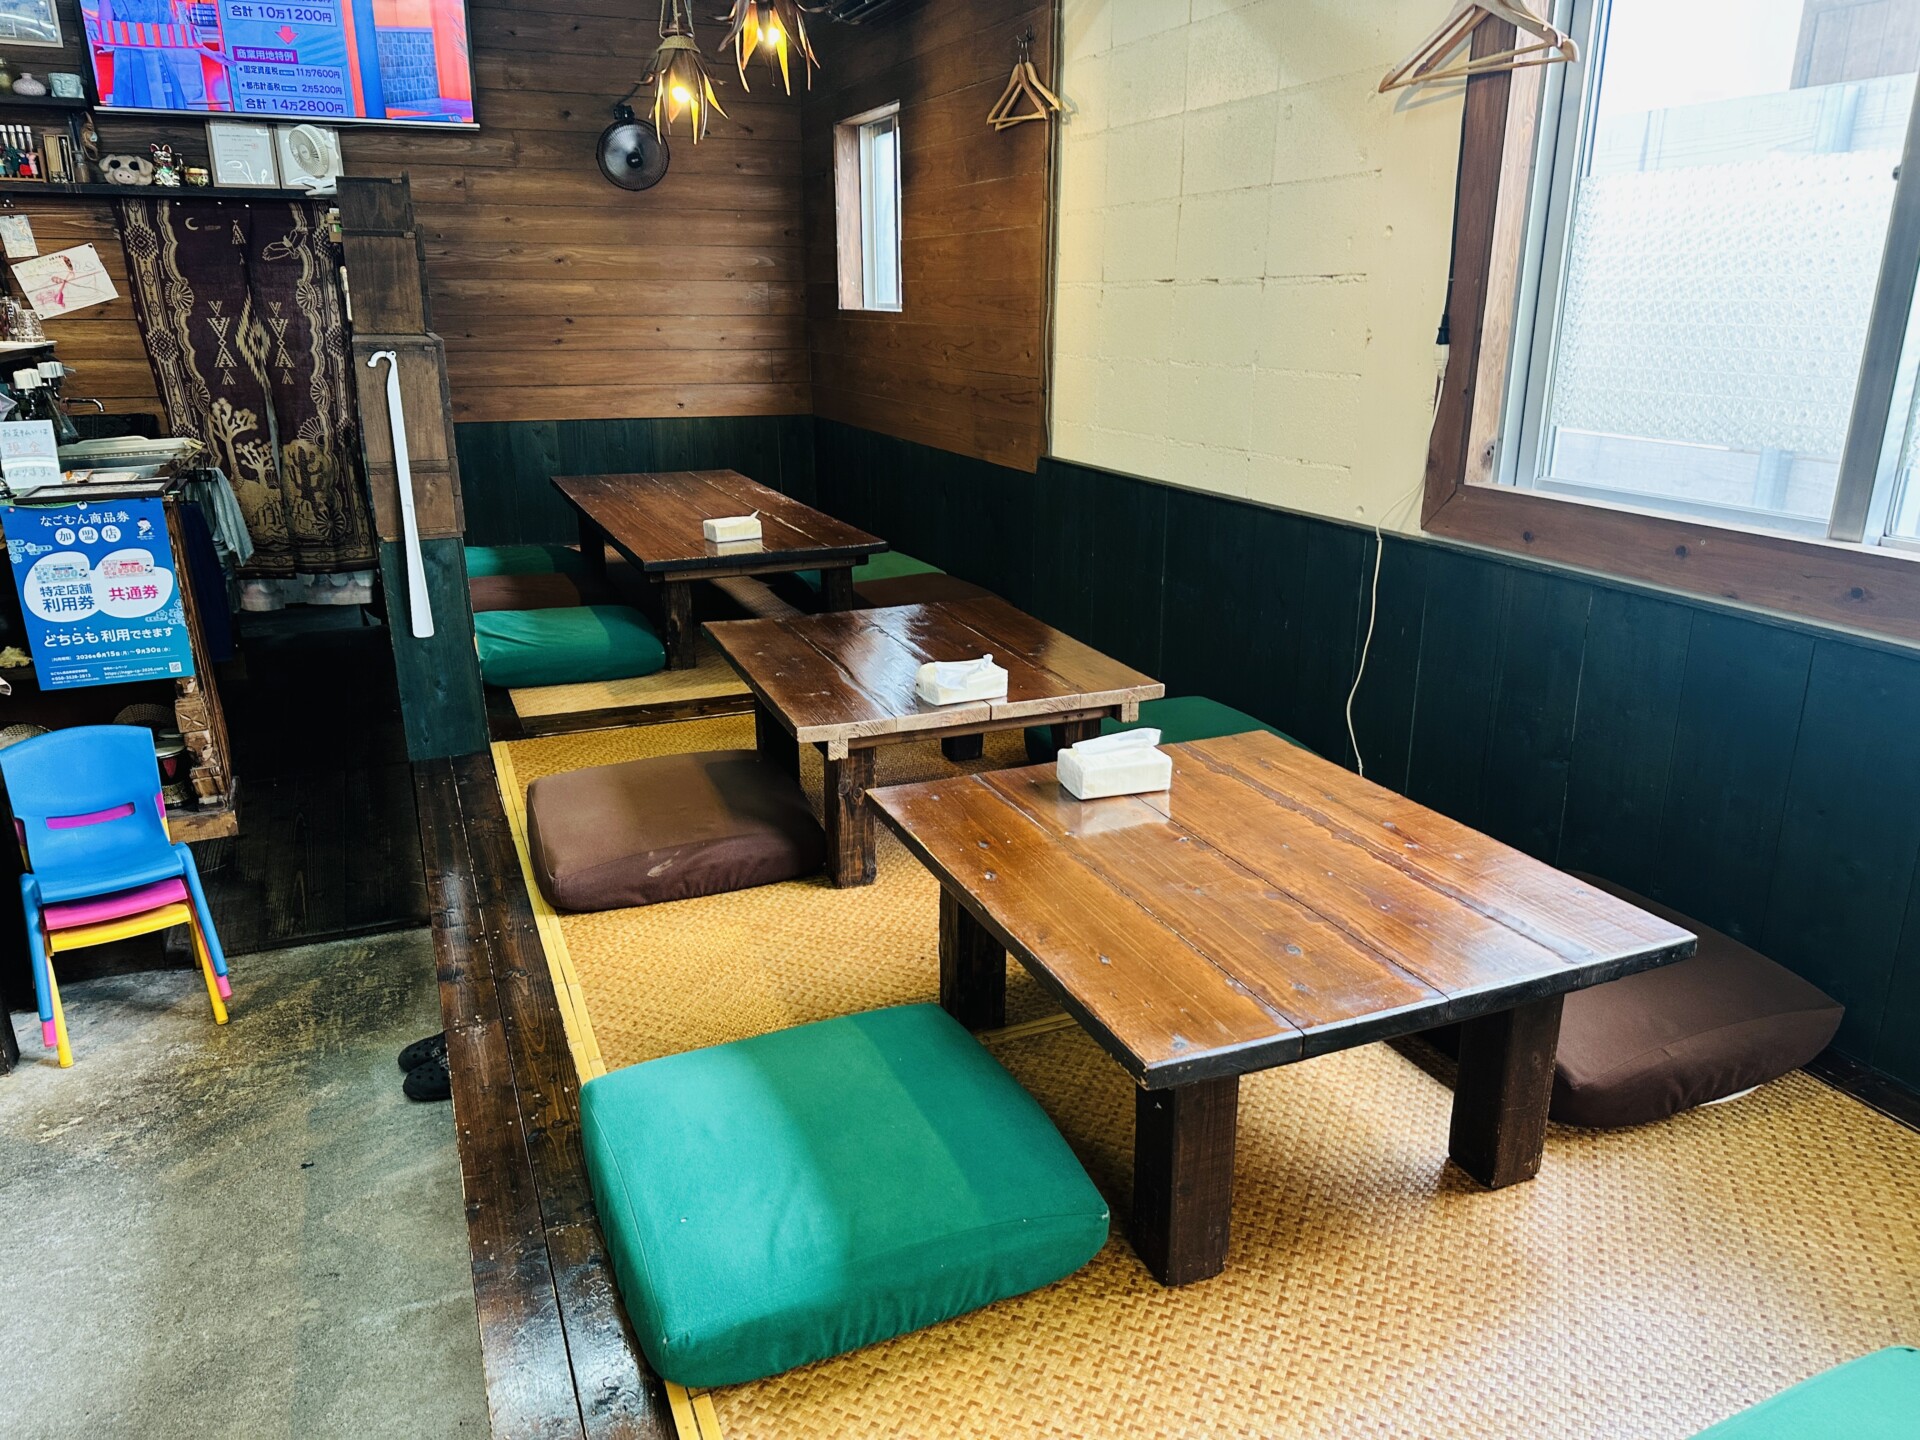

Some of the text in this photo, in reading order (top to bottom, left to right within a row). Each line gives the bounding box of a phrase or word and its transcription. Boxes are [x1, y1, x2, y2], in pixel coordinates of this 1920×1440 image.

[231, 5, 332, 22] 合計 10万1200円
[237, 49, 294, 61] 商業用地特例
[296, 68, 340, 79] 11万7600円
[302, 84, 342, 95] 2万5200円
[245, 98, 344, 114] 合計 14万2800円
[40, 511, 130, 526] なごむん商品券
[40, 583, 93, 597] 特定店舗
[108, 584, 159, 602] 共通券
[42, 595, 95, 613] 利用券
